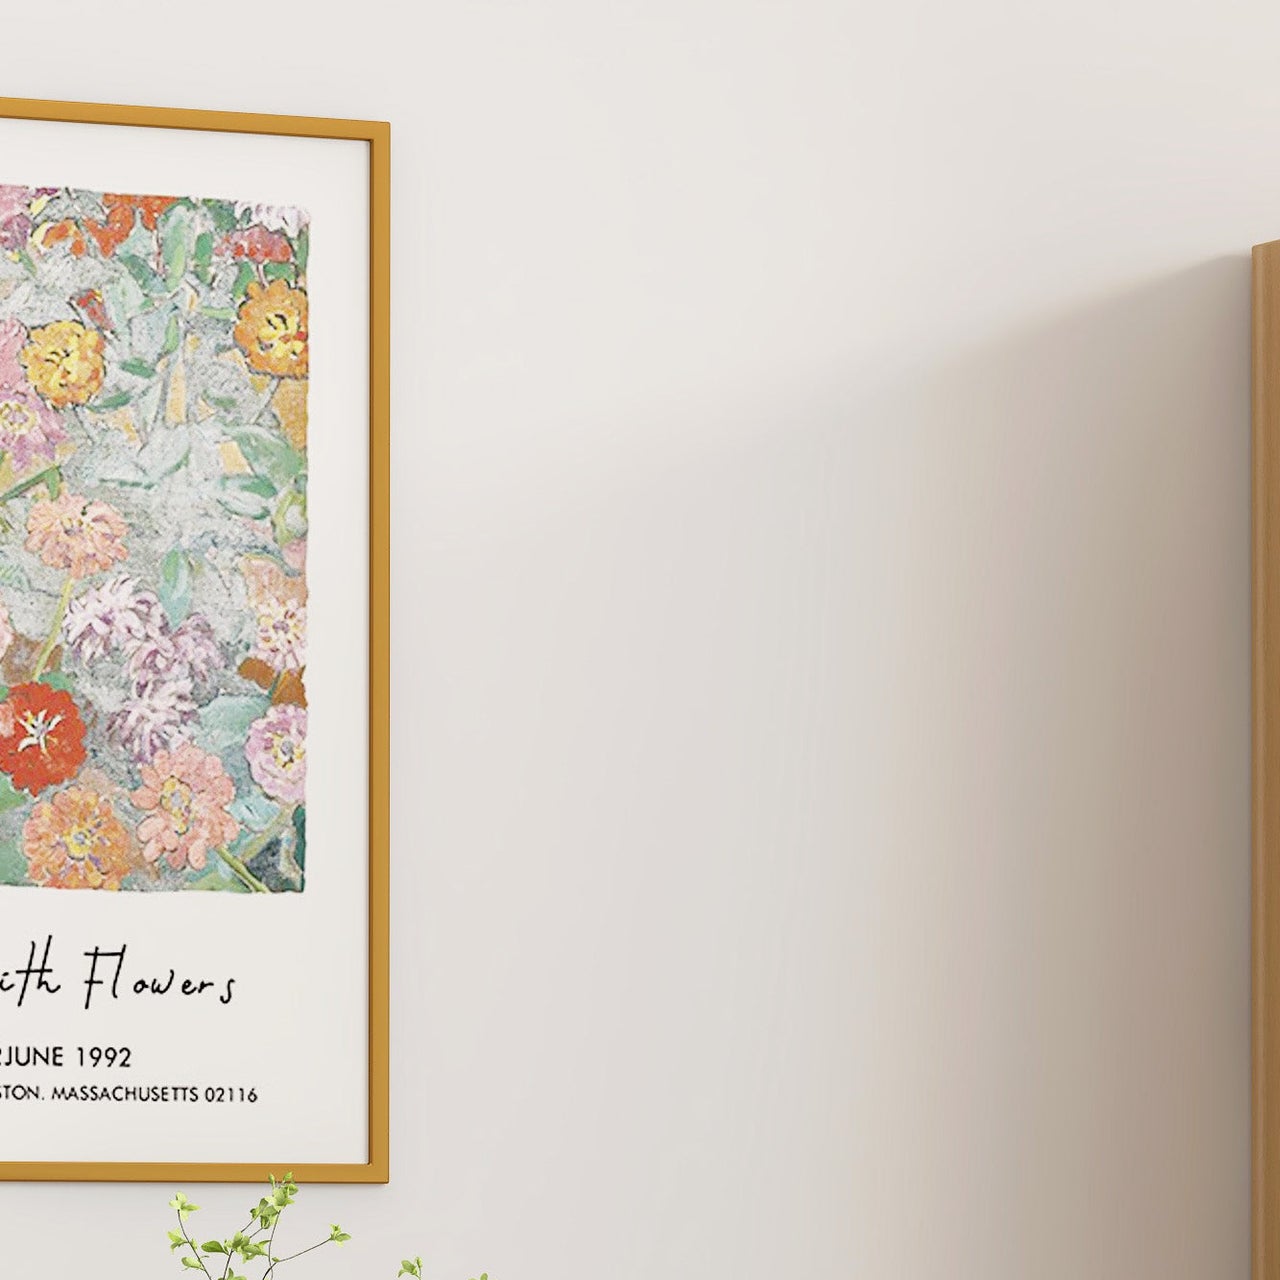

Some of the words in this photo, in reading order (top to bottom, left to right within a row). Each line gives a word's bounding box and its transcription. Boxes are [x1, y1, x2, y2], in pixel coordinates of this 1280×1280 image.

[83, 944, 236, 1010] Flowers
[0, 1046, 63, 1067] JUNE
[77, 1047, 132, 1068] 1992
[0, 1085, 45, 1101] TON.
[51, 1086, 199, 1102] MASSACHUSETTS
[204, 1087, 259, 1103] 02116
